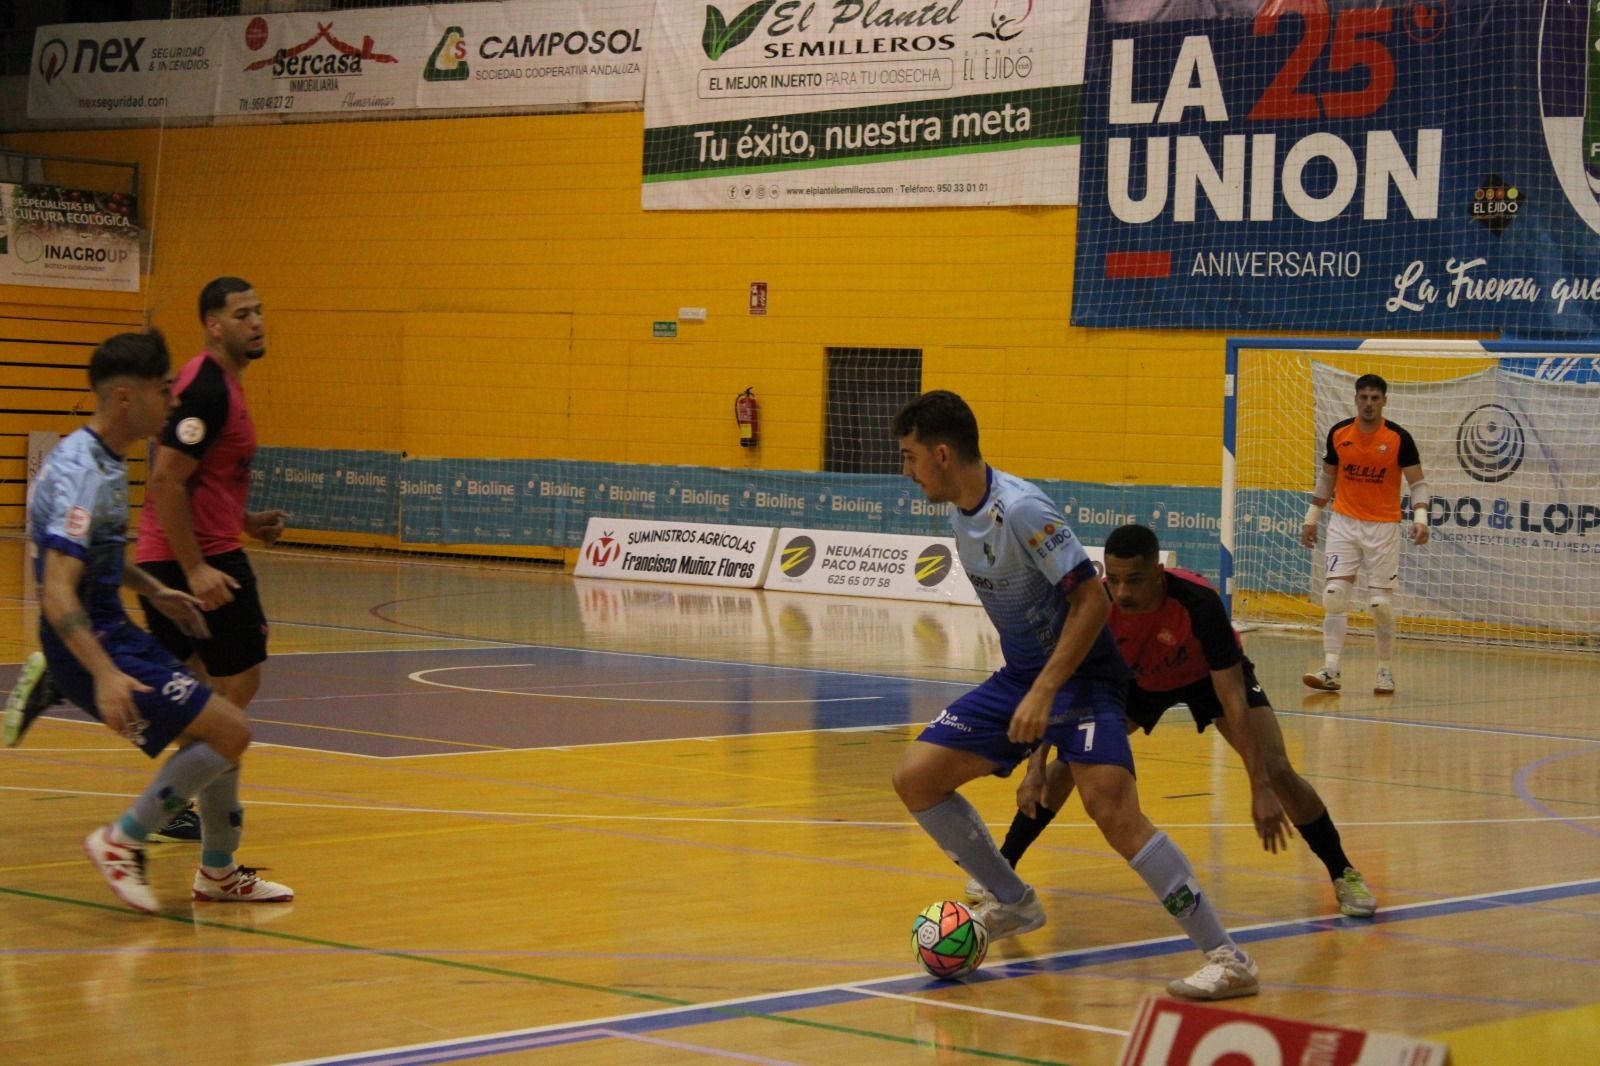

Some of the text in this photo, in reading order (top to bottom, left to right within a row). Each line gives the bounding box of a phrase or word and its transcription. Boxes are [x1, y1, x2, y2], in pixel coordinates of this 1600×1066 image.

[767, 0, 961, 36] El Plantel
[151, 46, 204, 58] SEGURIDAD
[479, 28, 642, 59] CAMPOSOL
[764, 34, 955, 59] SEMILLEROS
[72, 37, 146, 73] nex
[272, 49, 363, 76] Sercasa
[1247, 0, 1396, 120] 25
[157, 59, 209, 71] INCENDIOS
[475, 63, 640, 81] SOCIEDAD COOPERATIVA ANDALUZA
[290, 78, 339, 92] INMOBILIARIA
[709, 68, 941, 91] EL MEJOR INJERTO PARA TU COSECHA
[1108, 35, 1229, 124] LA
[694, 103, 1031, 162] Tu éxito, nuestra meta
[1107, 128, 1443, 223] UNION
[936, 183, 952, 193] 950
[954, 183, 965, 193] 33
[967, 183, 977, 192] 01
[19, 198, 96, 213] ESPECIALISTAS EN
[1474, 201, 1519, 214] EL EJIDO
[0, 207, 131, 227] RICULTURA ECOLÓGICA
[45, 244, 128, 263] INAGROUP
[1191, 251, 1361, 278] ANIVERSARIO
[1386, 257, 1600, 314] La Fuerza que
[284, 468, 325, 484] Bioline
[345, 471, 387, 487] Bioline
[467, 480, 515, 496] Bioline
[540, 481, 585, 497] Bioline
[609, 485, 656, 503] Bioline
[680, 488, 729, 506] Bioline
[755, 492, 805, 510] Bioline
[832, 495, 882, 513] Bioline
[1078, 508, 1136, 525] Bioline
[1488, 498, 1514, 530] &
[628, 529, 757, 554] SUMINISTROS AGRÍCOLAS
[825, 545, 909, 561] NEUMÁTICOS
[622, 552, 755, 578] Francisco Muñoz Flores
[821, 559, 906, 575] PACO RAMOS
[827, 575, 891, 588] 625 65 07 58
[1078, 722, 1096, 752] 7
